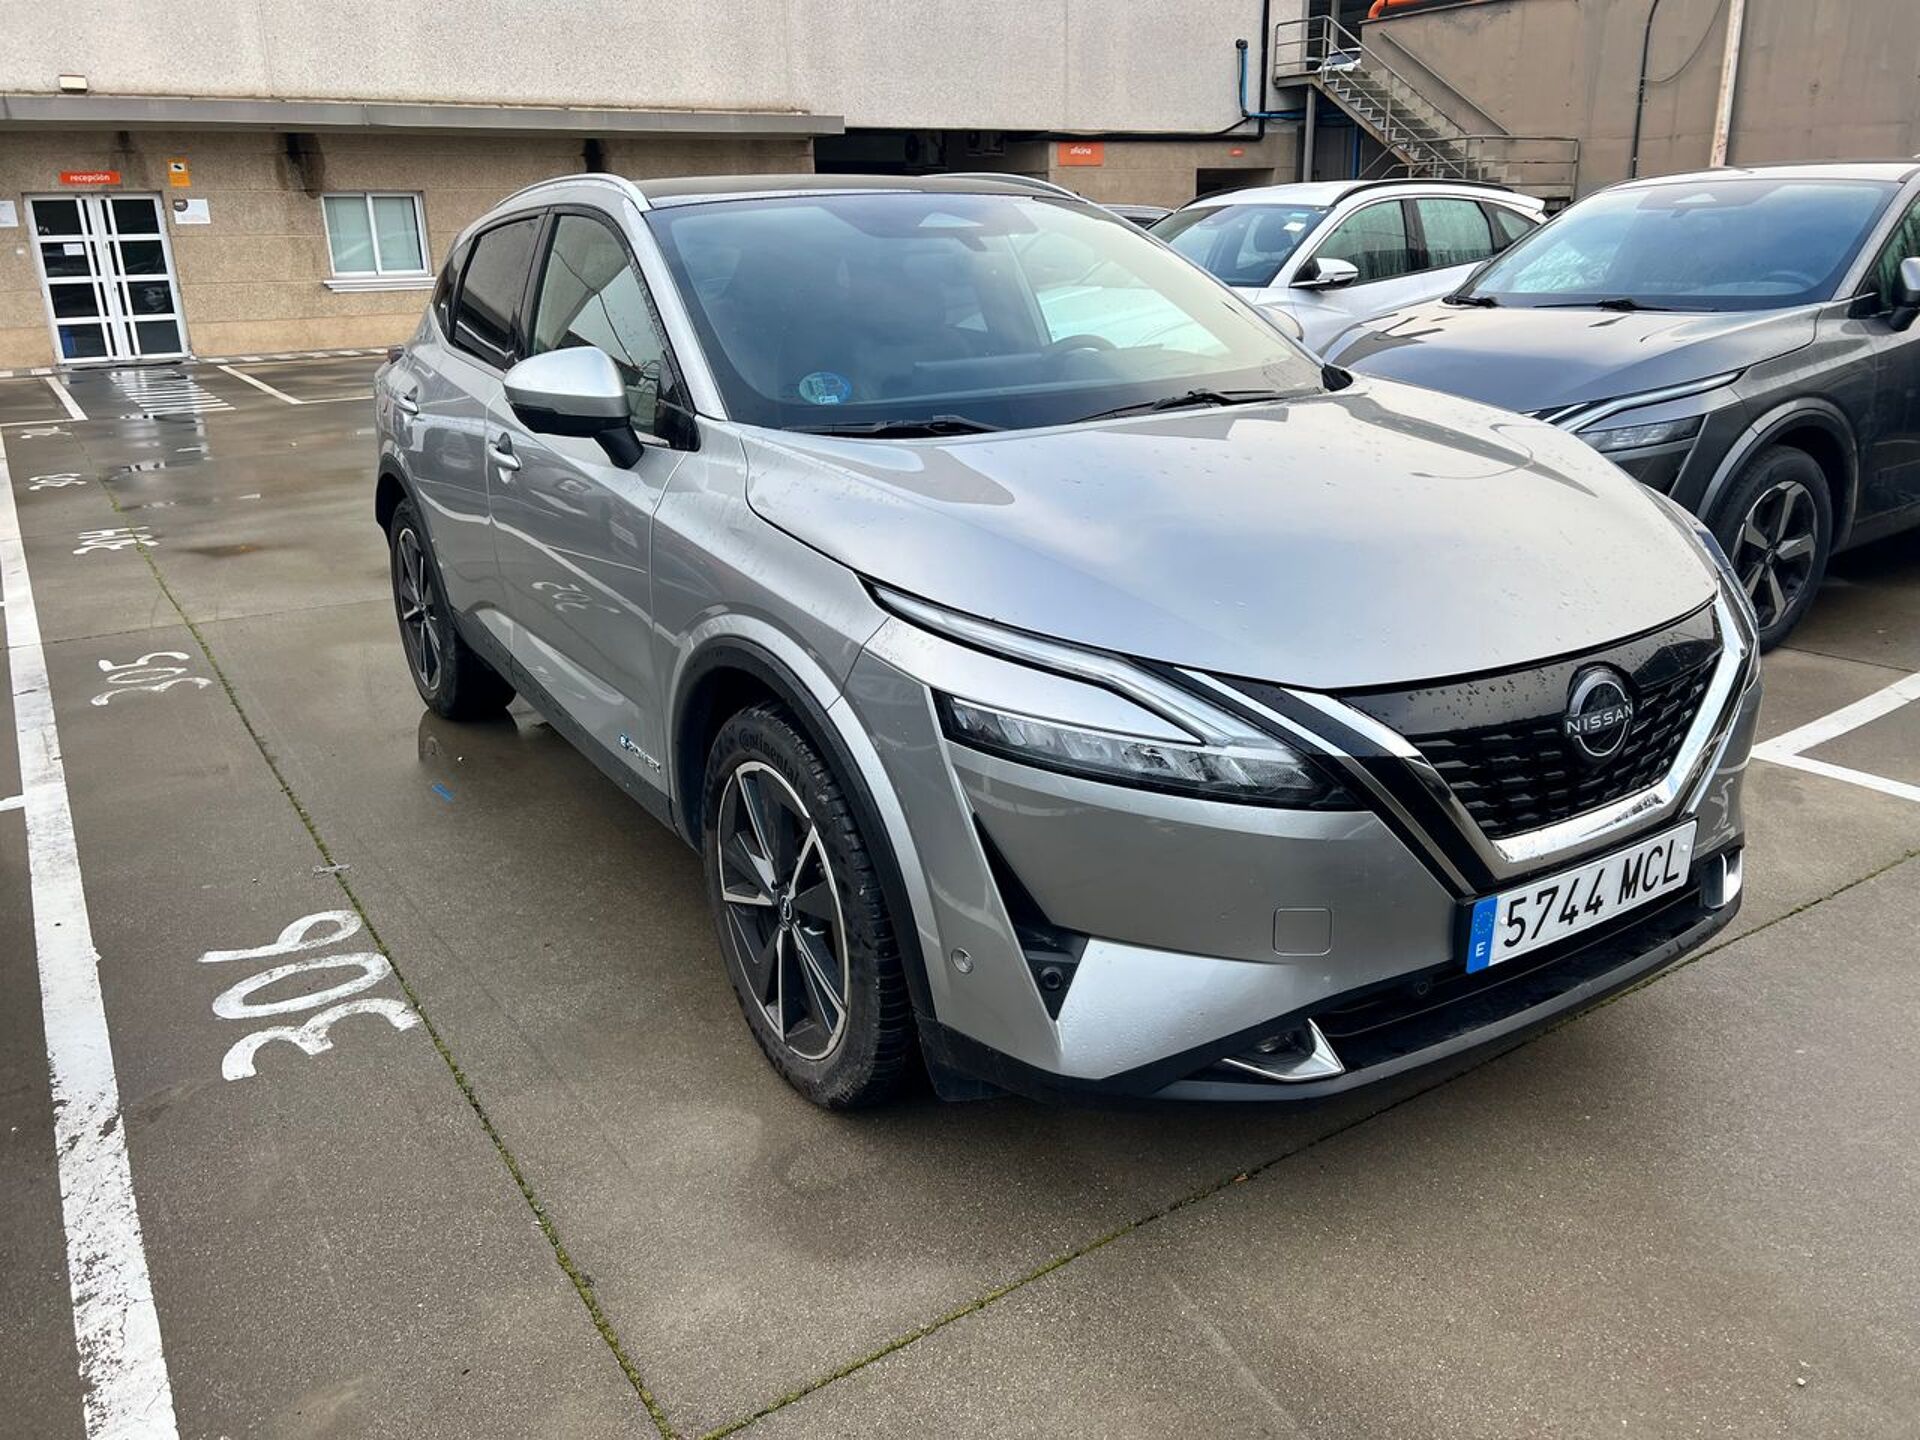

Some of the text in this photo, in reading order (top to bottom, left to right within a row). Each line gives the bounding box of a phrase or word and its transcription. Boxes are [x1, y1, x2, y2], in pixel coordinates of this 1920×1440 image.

[70, 173, 110, 183] recepción
[91, 652, 213, 706] 305
[1566, 702, 1633, 735] NISSAN
[1475, 839, 1680, 957] E 5744 MCL
[197, 910, 424, 1081] 306
